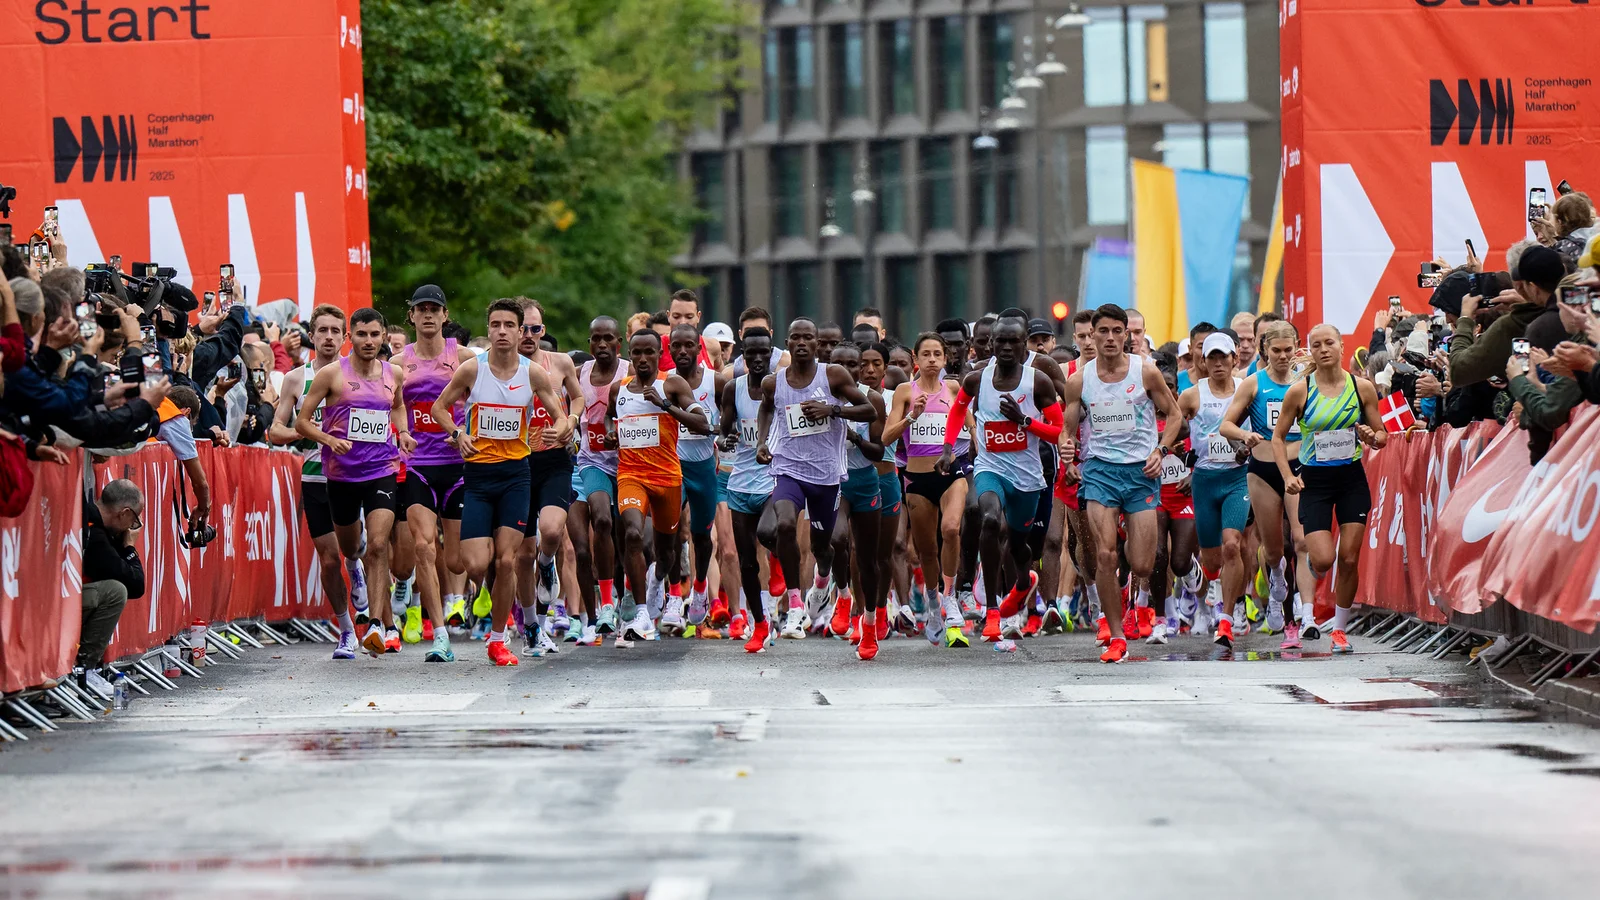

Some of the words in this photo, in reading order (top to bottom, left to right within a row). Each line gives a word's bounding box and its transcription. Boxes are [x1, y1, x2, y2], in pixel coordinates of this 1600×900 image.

[36, 0, 211, 45] Start
[1524, 76, 1592, 88] Copenhagen
[1525, 90, 1546, 99] Half
[147, 113, 215, 124] Copenhagen
[148, 126, 169, 136] Half
[1526, 134, 1552, 145] 2025
[150, 171, 175, 181] 2025
[480, 415, 520, 432] Lillesø
[1092, 413, 1133, 424] Sesemann
[350, 417, 388, 435] Dever
[620, 427, 657, 440] Nageeye
[985, 429, 1026, 445] Pace
